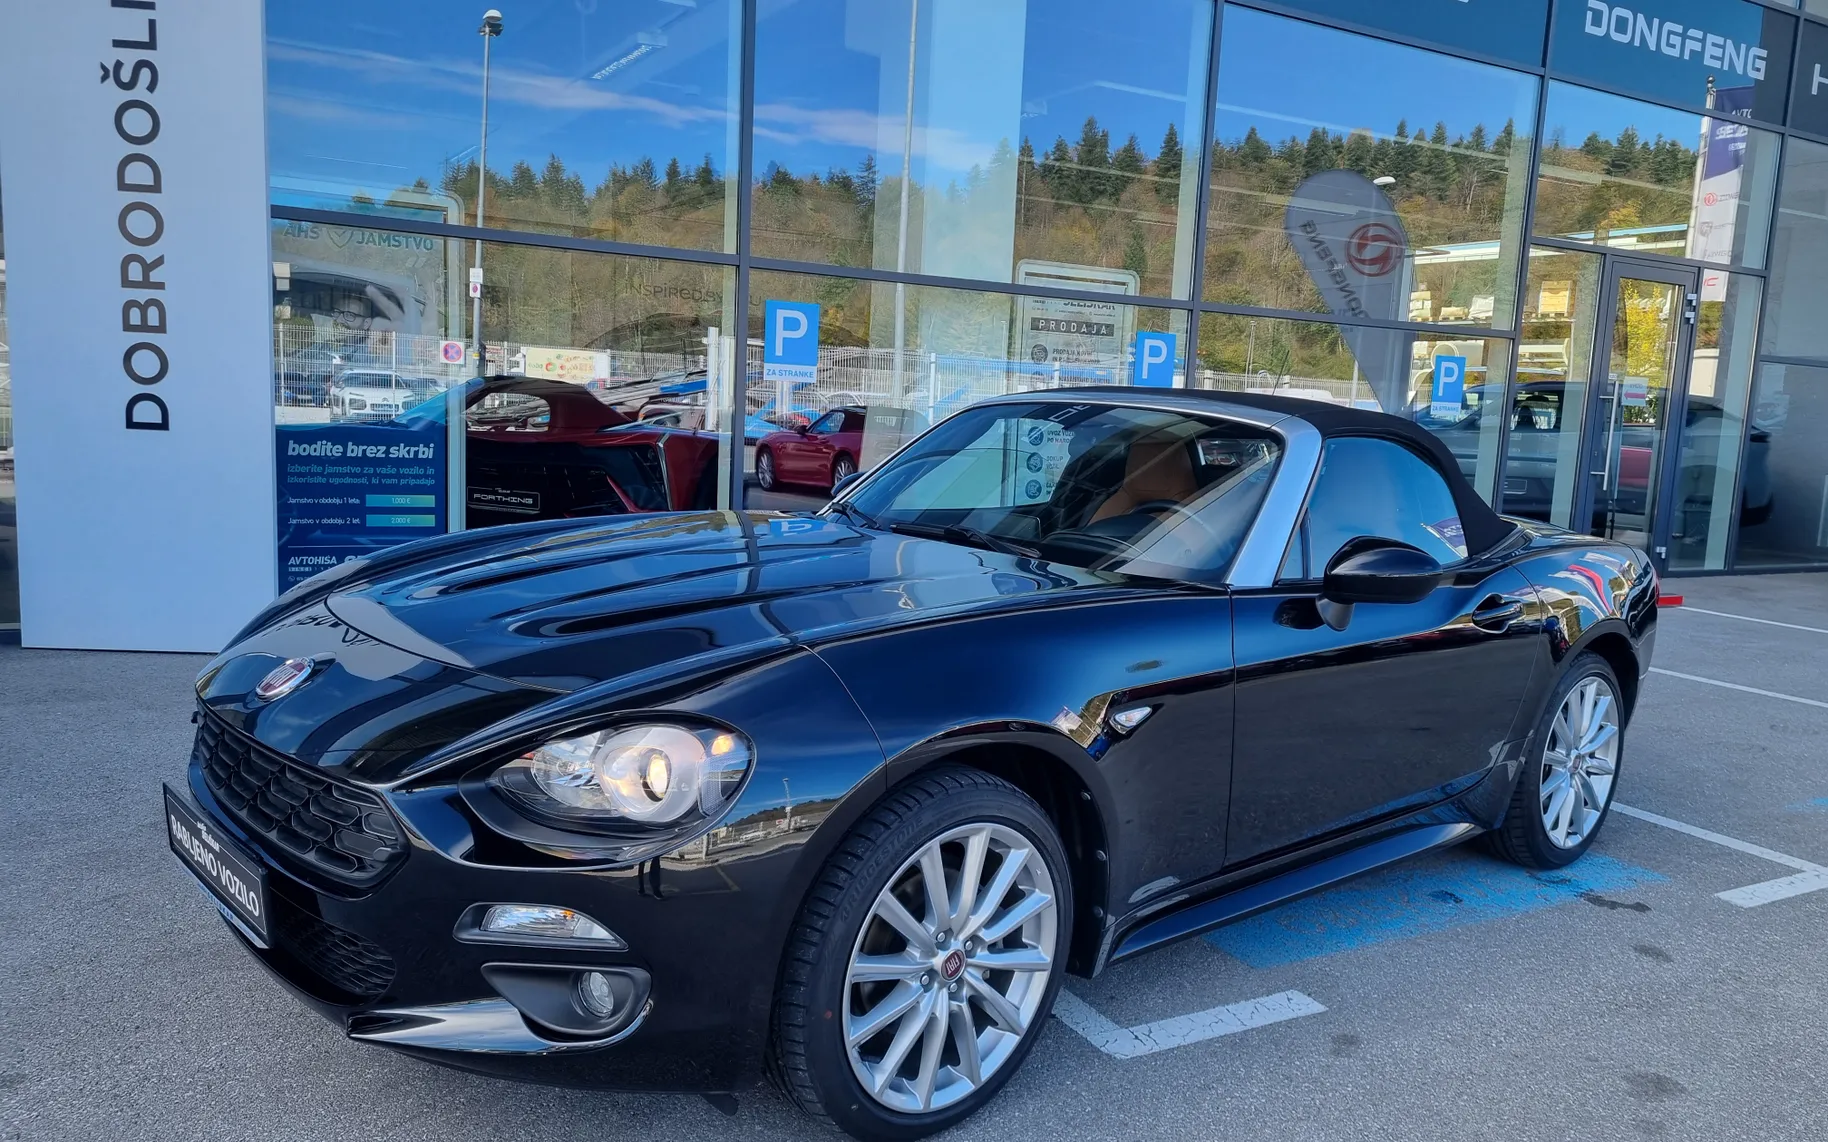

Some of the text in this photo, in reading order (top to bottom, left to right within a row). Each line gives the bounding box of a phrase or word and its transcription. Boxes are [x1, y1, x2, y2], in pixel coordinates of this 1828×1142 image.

[1584, 0, 1768, 81] DONGFENG
[100, 0, 169, 431] DOBRODOŠLI
[356, 230, 434, 251] JAMSTVO
[775, 309, 808, 356] P
[1039, 319, 1107, 335] PRODAJA
[1141, 338, 1168, 379] P
[766, 368, 814, 378] ZA STRANKE
[1438, 361, 1459, 397] P
[287, 440, 435, 459] bodite brez skrbi
[287, 464, 322, 473] izberite
[324, 465, 361, 475] jamstvo
[376, 465, 396, 474] vaše
[399, 466, 424, 475] vozilo
[427, 466, 435, 475] in
[287, 476, 327, 484] izkoristite
[371, 477, 379, 485] ki
[400, 477, 435, 487] pripadajo
[287, 496, 313, 504] Jamstvo
[319, 497, 343, 505] obdobju
[474, 493, 533, 505] FORTHING
[287, 517, 314, 525] Jamstvo
[321, 517, 345, 526] obdobju
[170, 814, 218, 877] RABLJENO
[217, 860, 260, 917] VOZILO
[945, 954, 961, 976] FIAT
